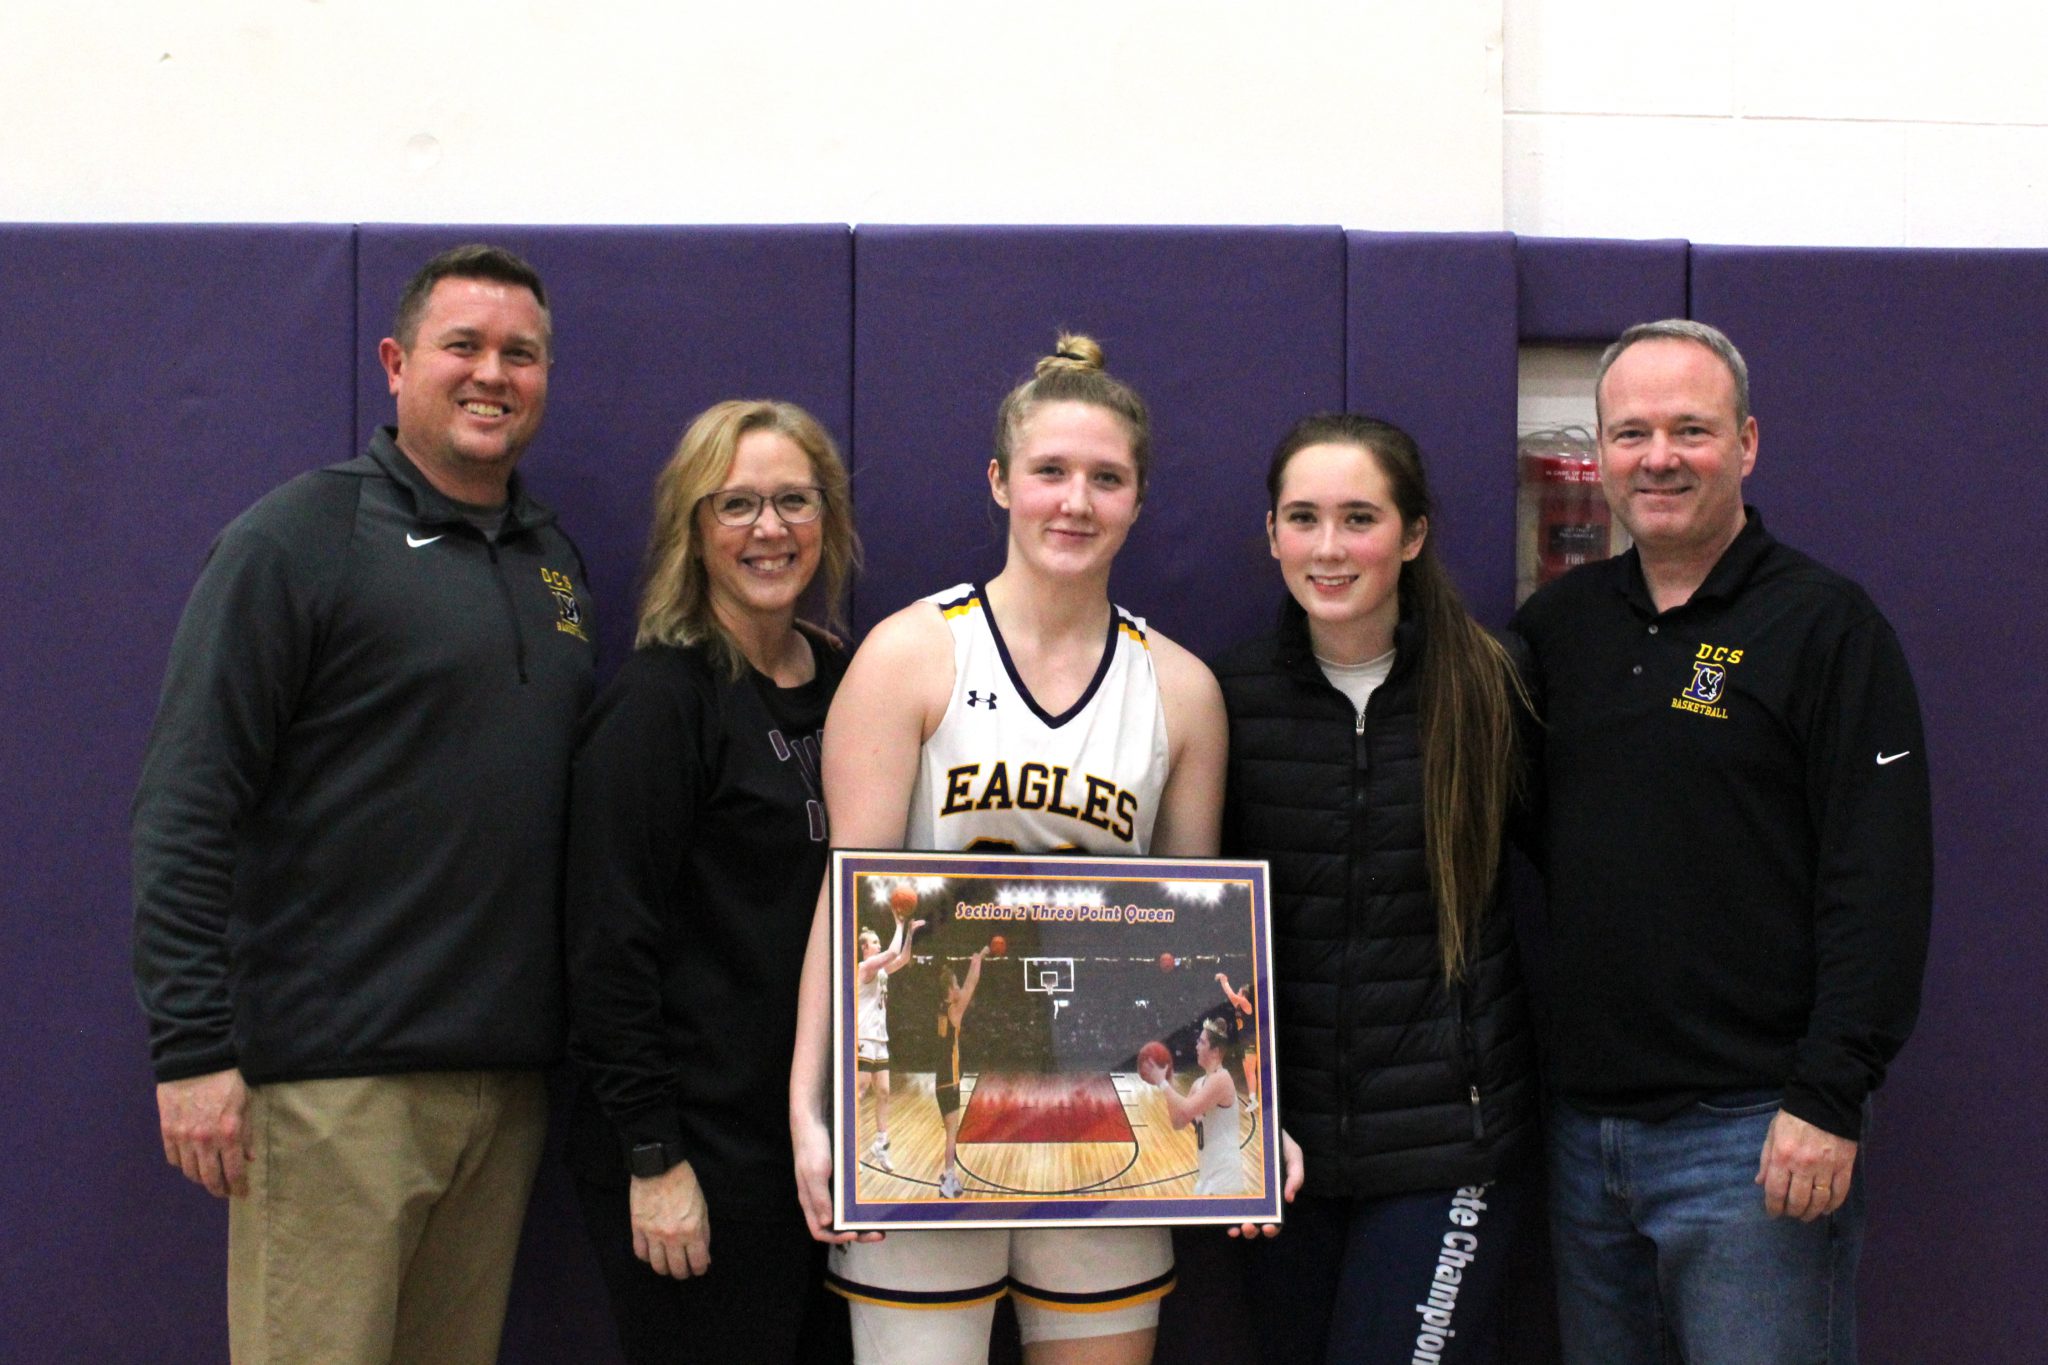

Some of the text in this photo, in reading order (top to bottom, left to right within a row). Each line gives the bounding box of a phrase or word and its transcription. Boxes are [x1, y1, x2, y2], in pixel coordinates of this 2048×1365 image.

[540, 567, 573, 591] DCS
[1695, 643, 1744, 664] DCS
[1671, 697, 1729, 719] BASKETBALL
[939, 760, 1138, 843] EAGLES
[955, 901, 1175, 924] Section 2 Three Point Queen
[1448, 1181, 1494, 1227] ate
